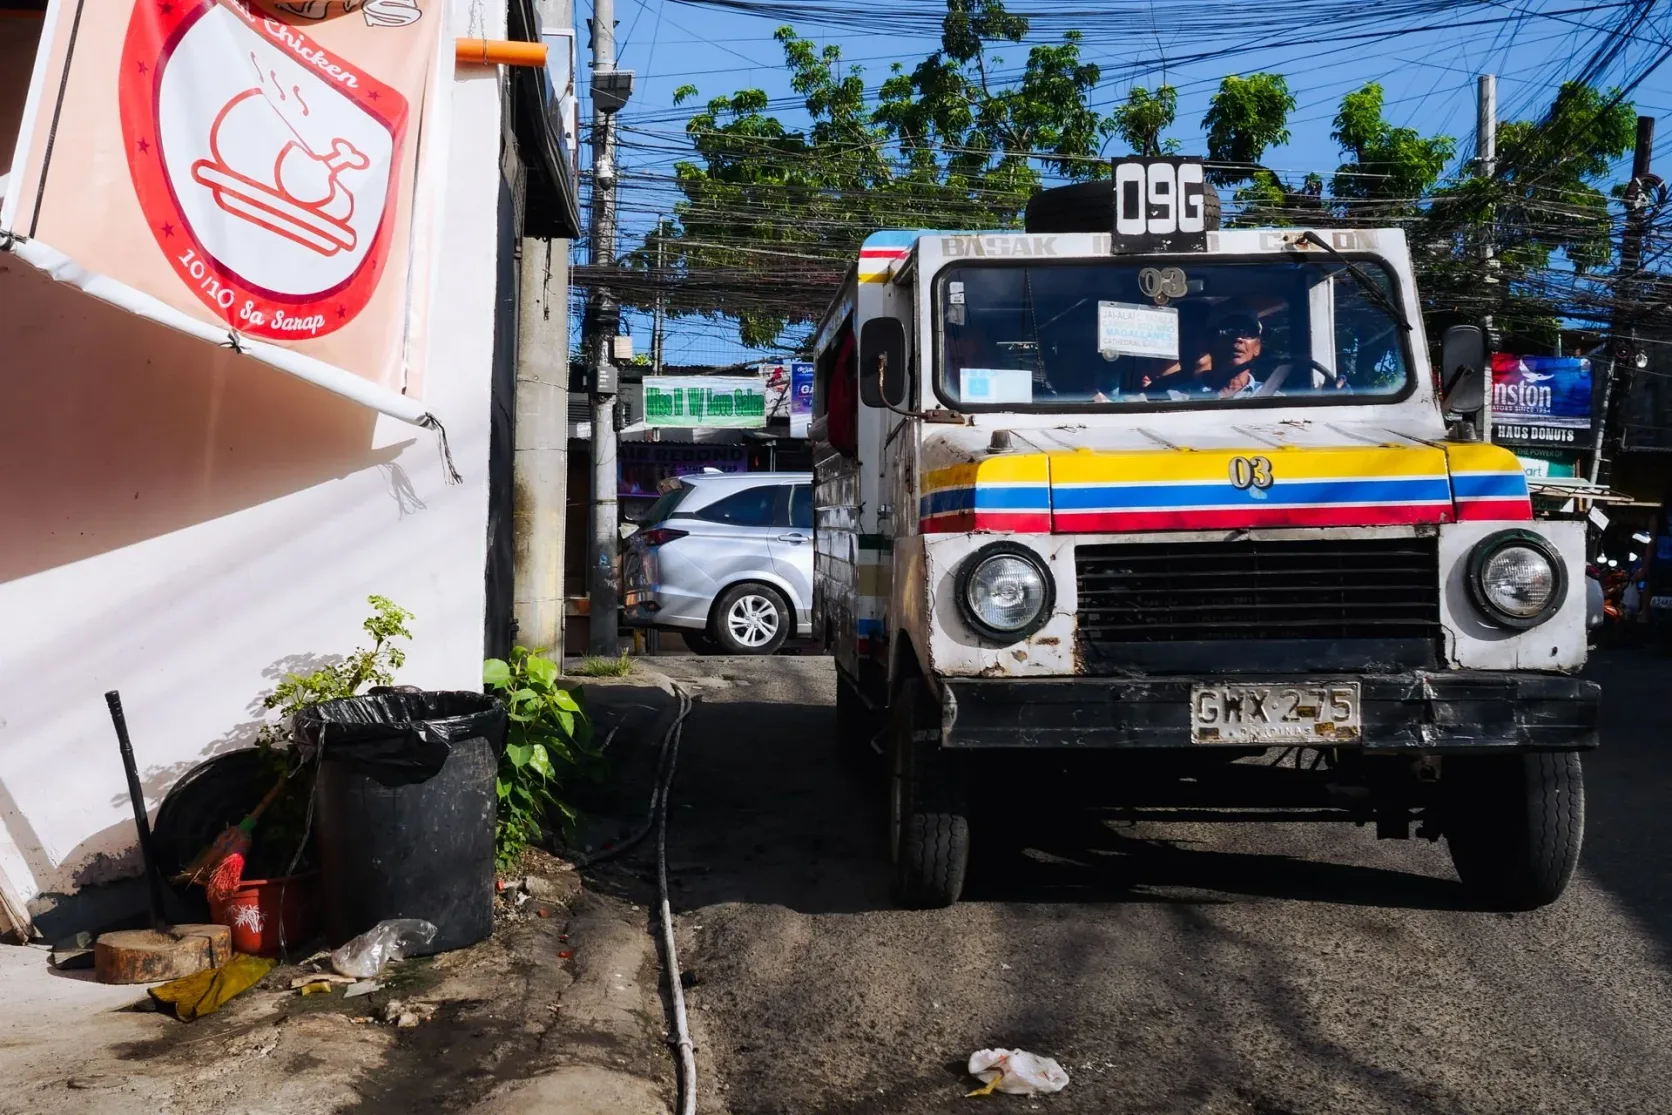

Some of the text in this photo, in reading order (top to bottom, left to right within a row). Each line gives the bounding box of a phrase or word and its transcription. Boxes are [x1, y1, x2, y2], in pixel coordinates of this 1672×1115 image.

[263, 15, 358, 88] Chicken
[941, 234, 1058, 256] BASAK
[178, 248, 325, 334] 10/10 Sa Sarap
[1138, 266, 1188, 298] 03
[1106, 327, 1173, 341] MAGALLANES
[1491, 380, 1551, 408] nston
[1497, 425, 1575, 442] HAUS DONUTS
[1228, 455, 1273, 489] 03
